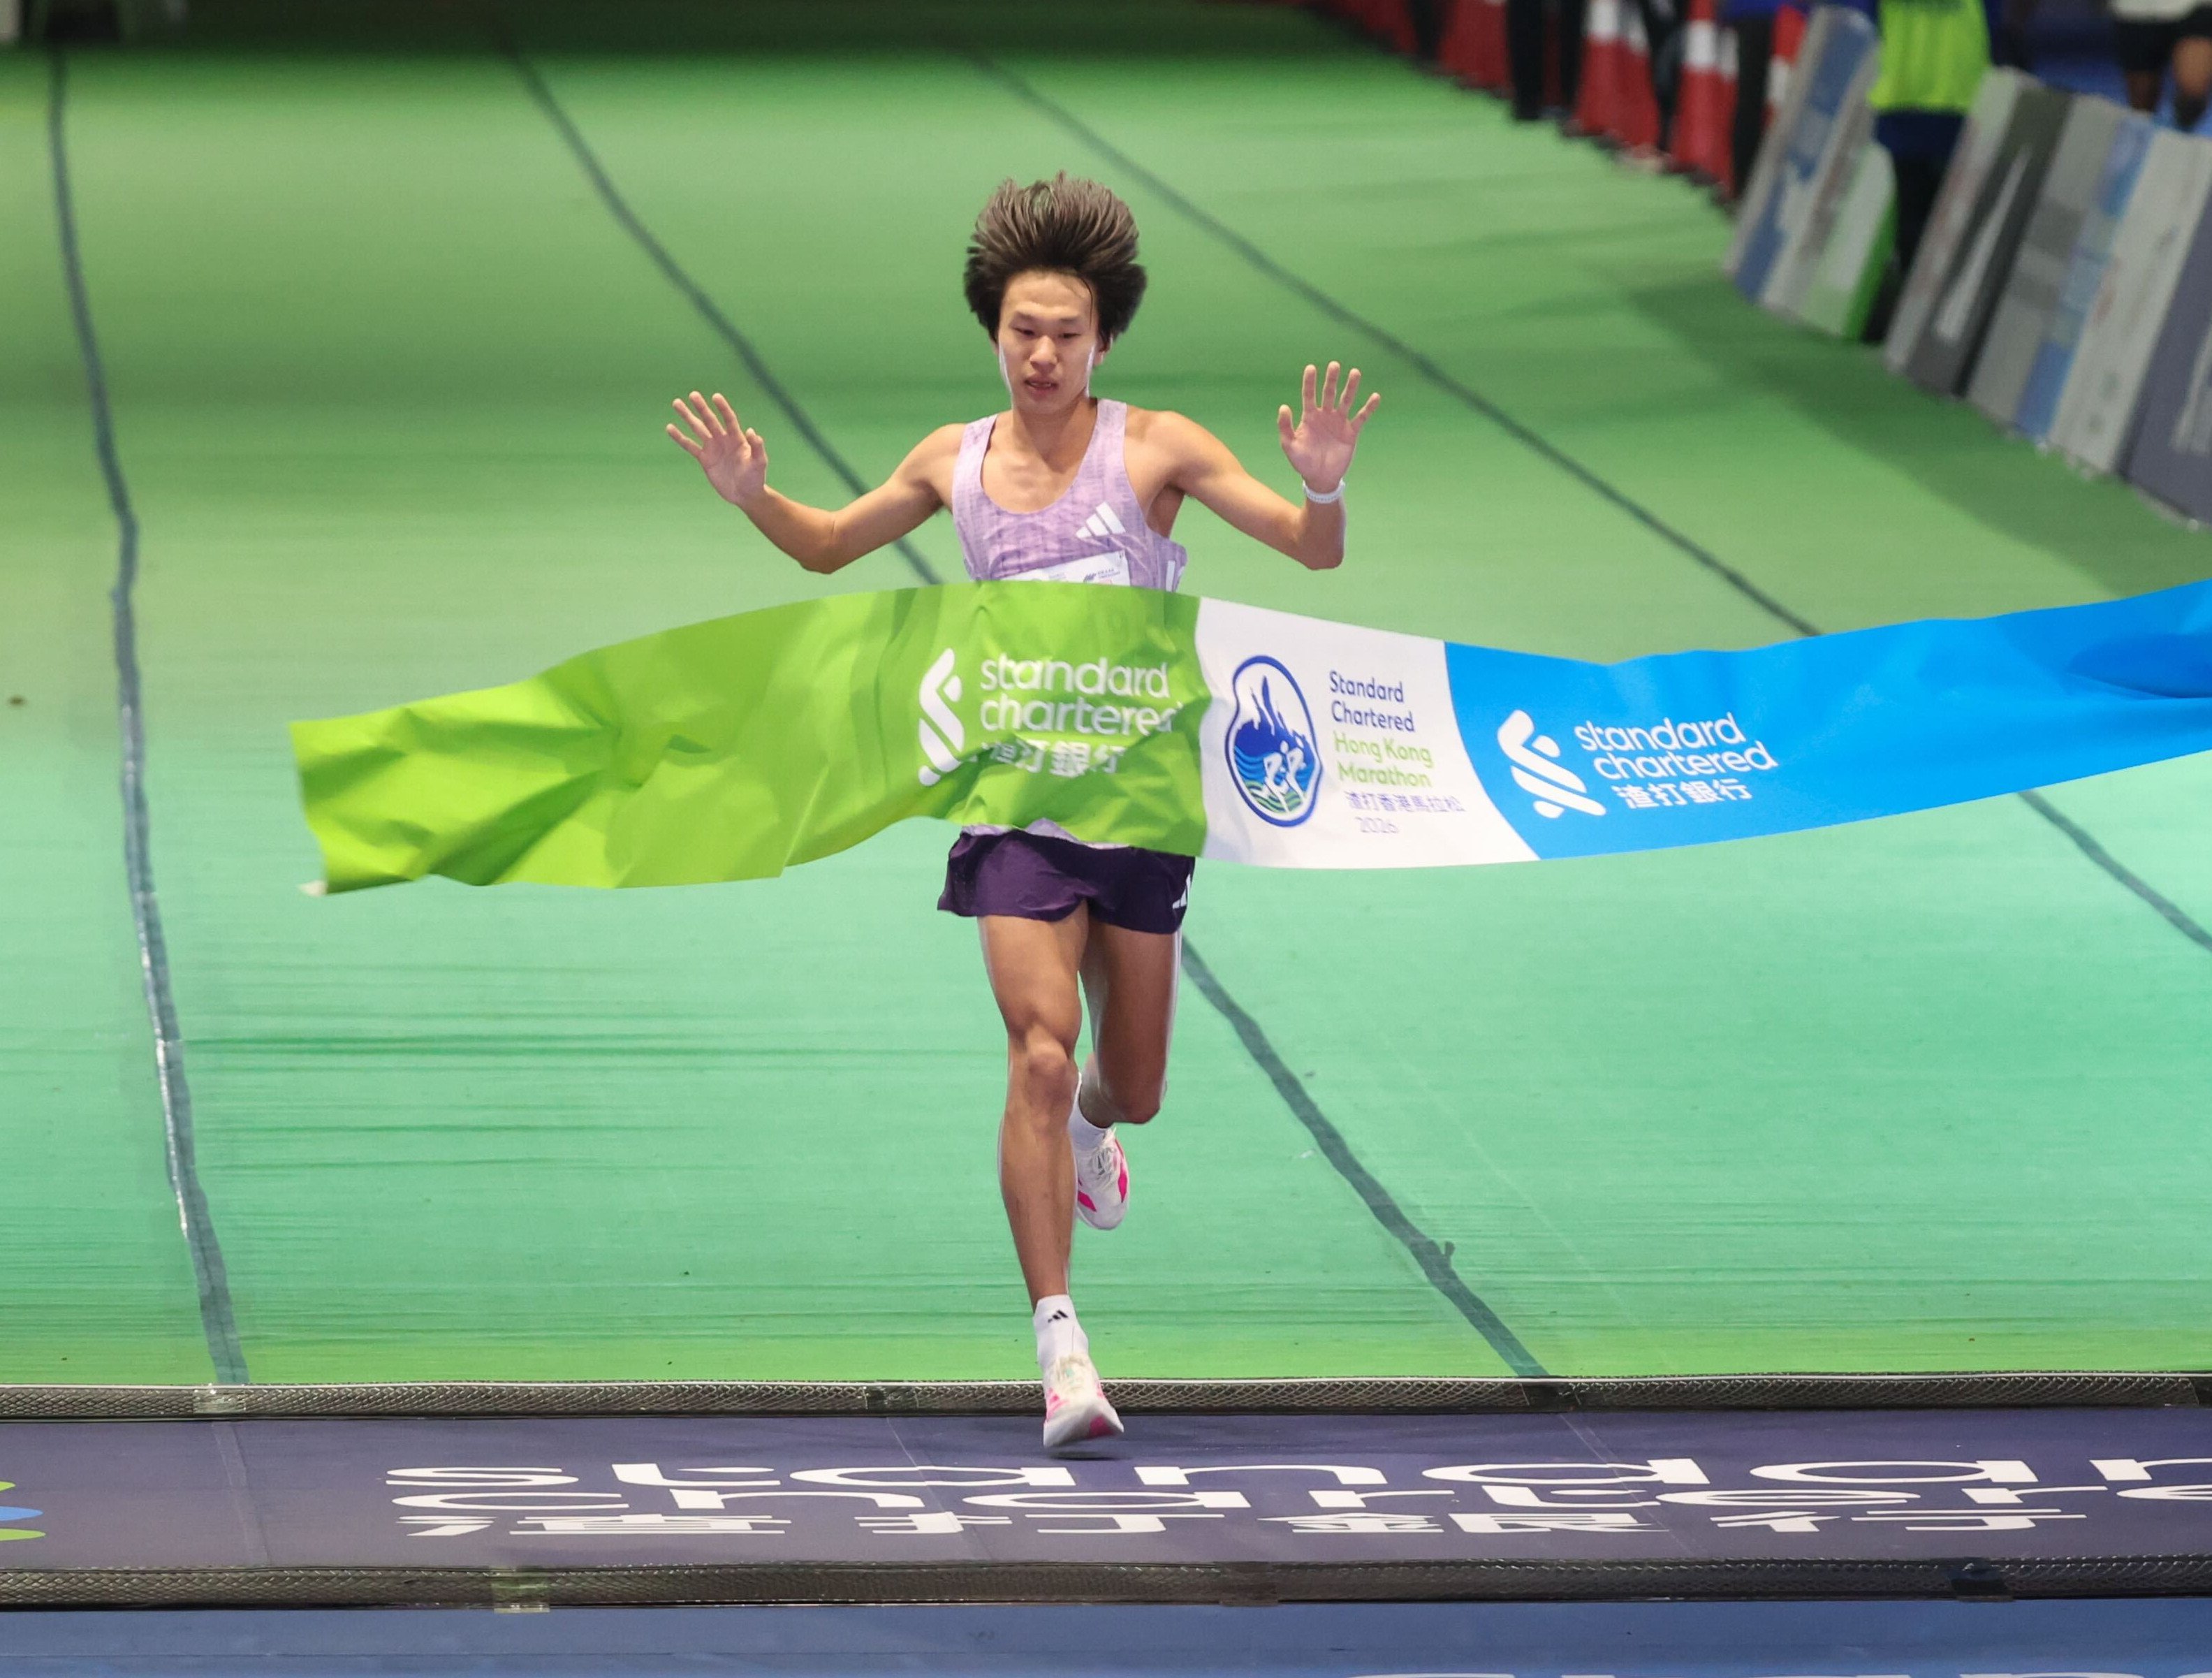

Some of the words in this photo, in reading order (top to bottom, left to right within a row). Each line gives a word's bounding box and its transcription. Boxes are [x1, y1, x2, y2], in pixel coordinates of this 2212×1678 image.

[980, 652, 1171, 699] standard
[1330, 671, 1405, 703] Standard
[1332, 700, 1415, 733] Chartered
[1574, 711, 1745, 752] standard
[1333, 731, 1383, 763] Hong
[1384, 738, 1434, 768] Kong
[1593, 740, 1779, 780] chartered
[1338, 761, 1433, 787] Marathon
[1611, 778, 1752, 810] 渣打銀行
[395, 1508, 2087, 1537] 渣打銀行
